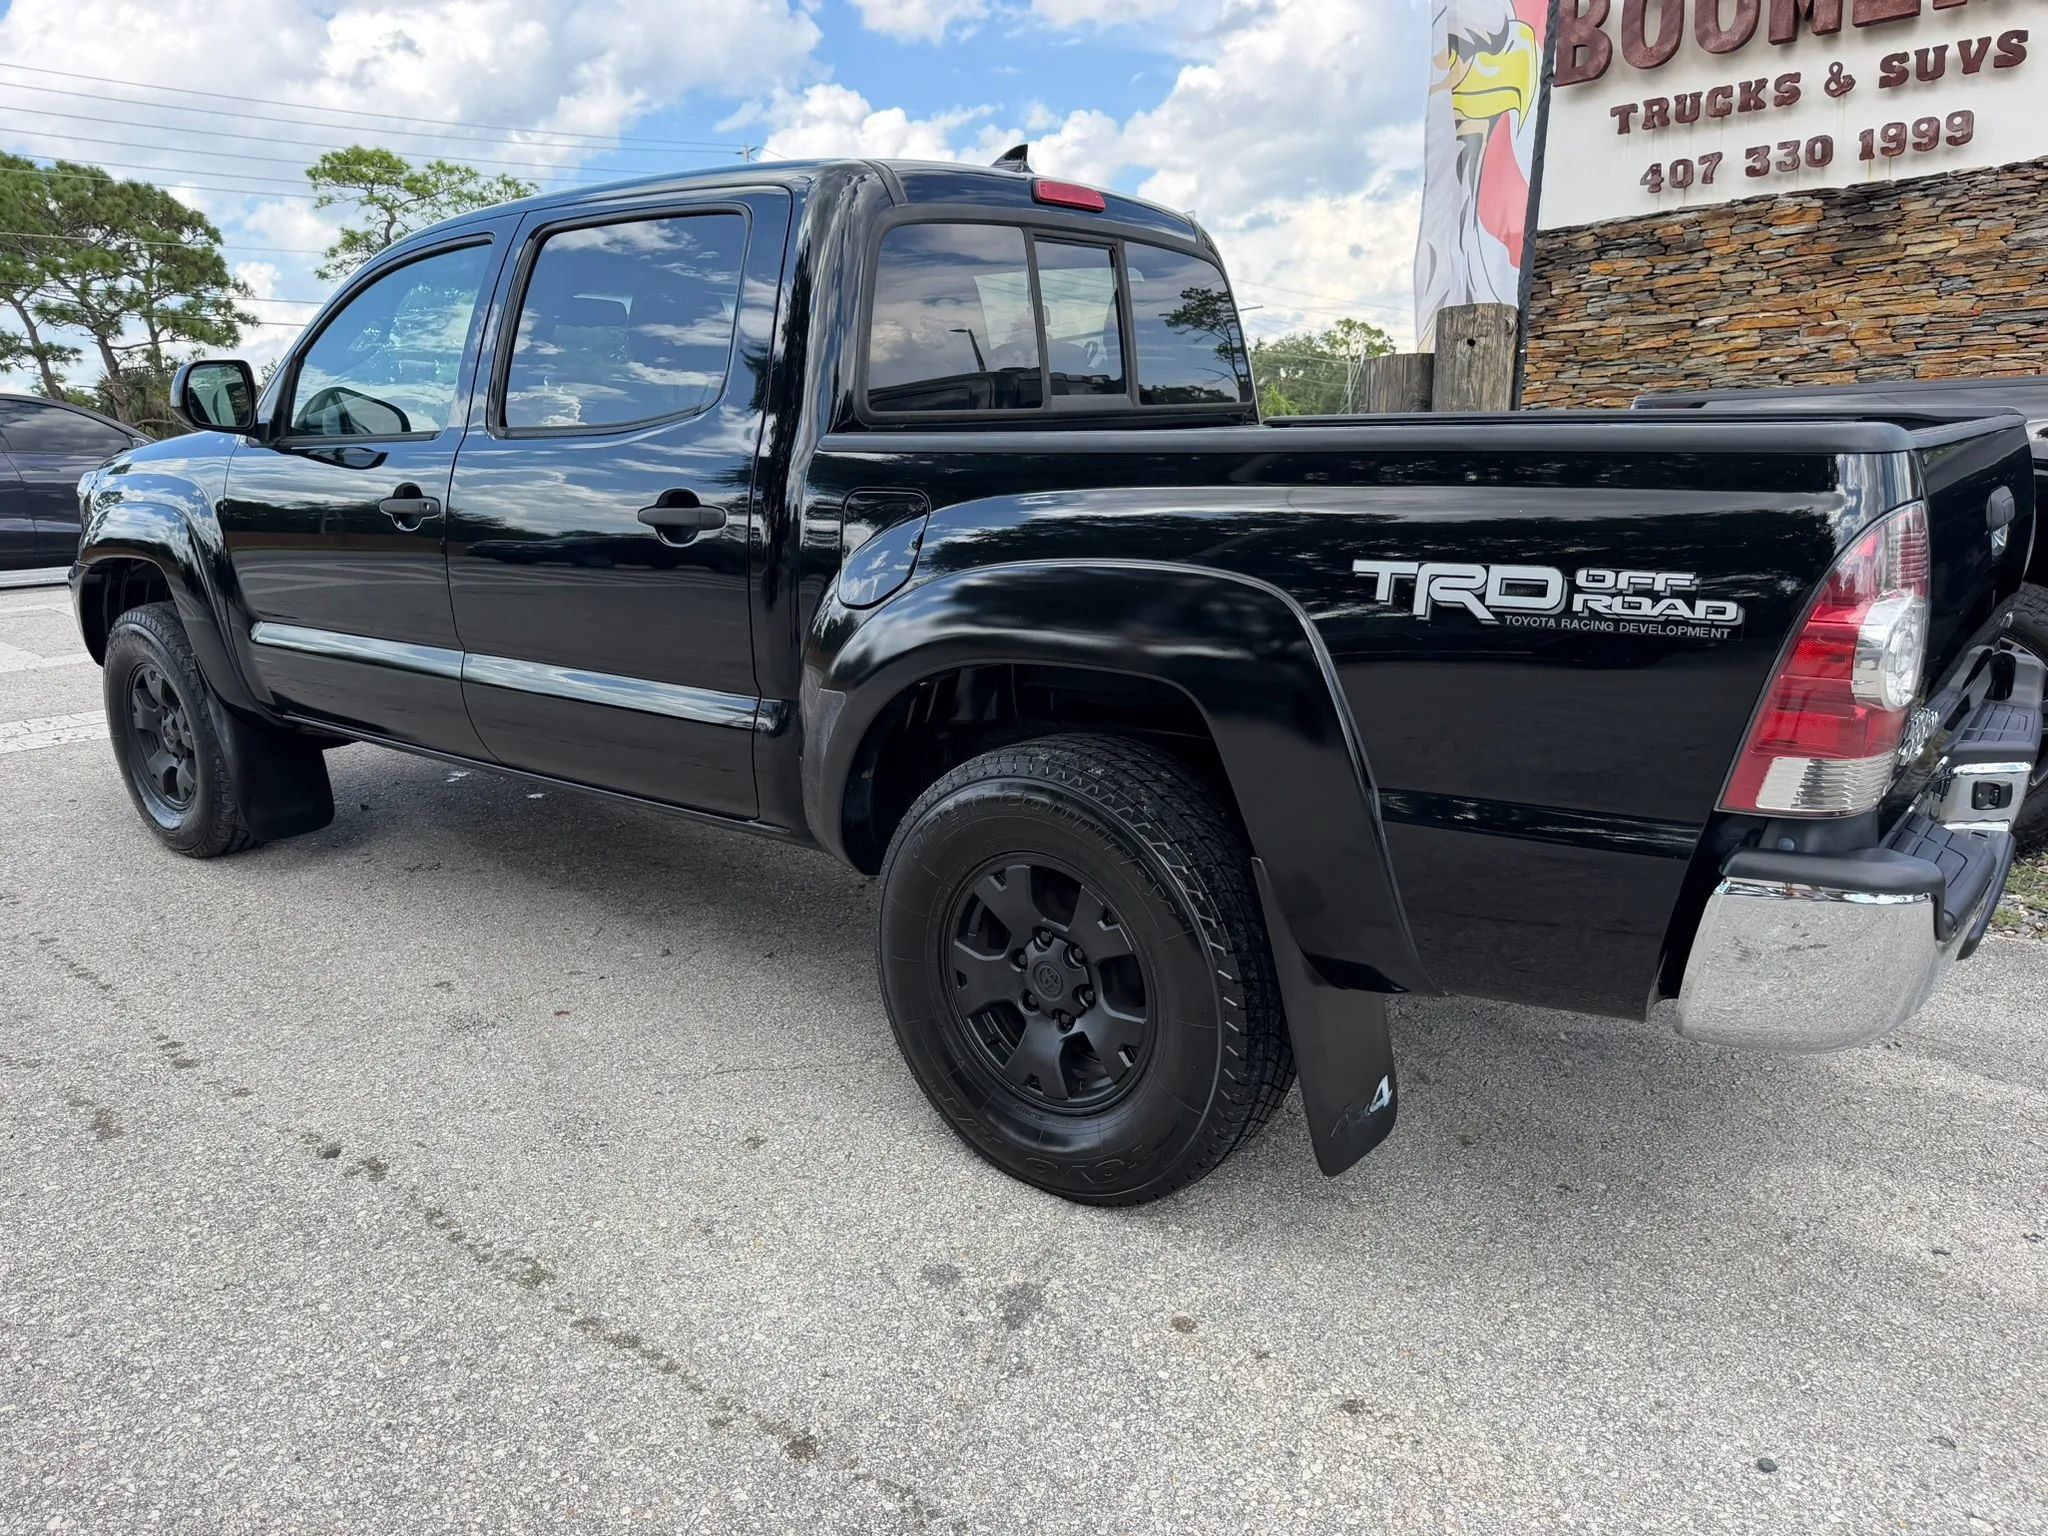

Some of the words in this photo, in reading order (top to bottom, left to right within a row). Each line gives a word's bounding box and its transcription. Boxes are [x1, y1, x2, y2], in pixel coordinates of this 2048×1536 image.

[1610, 72, 1801, 135] TRUCKS
[1824, 61, 1857, 98] &
[1878, 29, 2029, 89] SUVS
[1639, 151, 1724, 194] 407
[1744, 134, 1834, 178] 330
[1858, 109, 1975, 161] 1999
[1352, 559, 1567, 625] TRD
[1575, 569, 1700, 595] OFF
[1504, 615, 1556, 629] TOYOTA
[1560, 618, 1615, 633] RACING
[1618, 622, 1732, 640] DEVELOPMENT
[1572, 593, 1745, 625] ROAD
